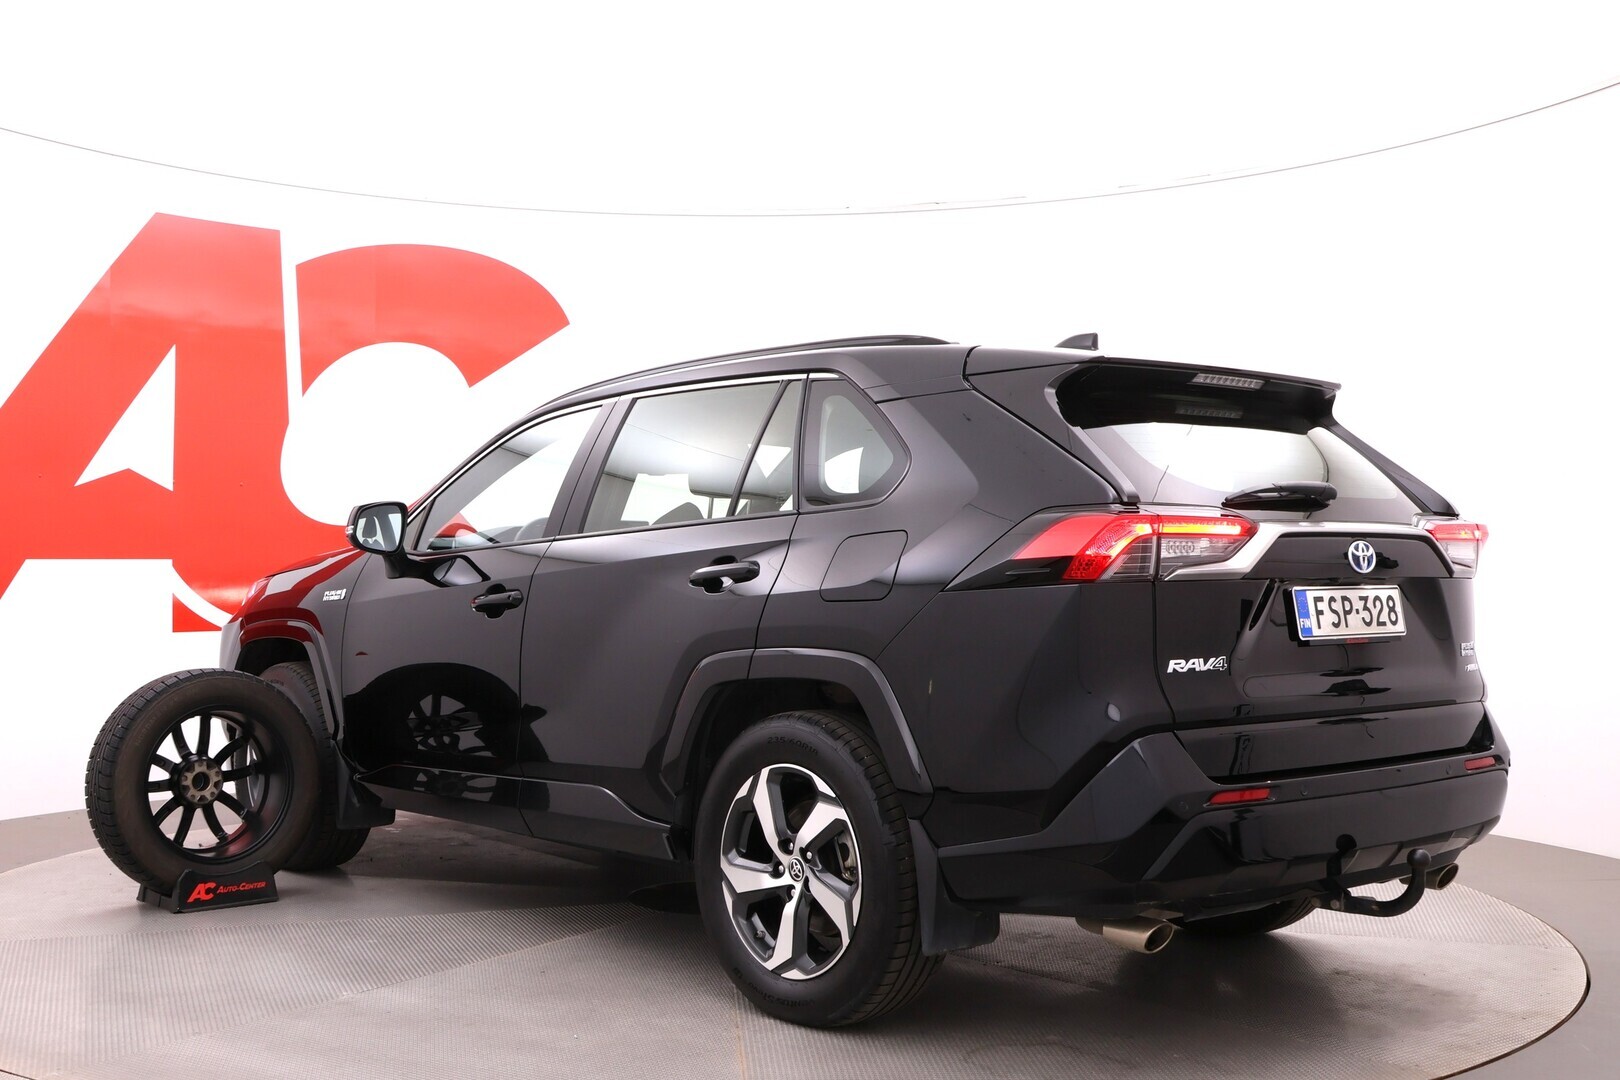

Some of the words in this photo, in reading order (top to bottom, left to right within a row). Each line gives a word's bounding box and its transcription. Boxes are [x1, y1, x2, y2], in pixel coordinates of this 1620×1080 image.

[1313, 594, 1399, 629] FSP-328
[1300, 618, 1311, 628] FIN
[1167, 656, 1227, 673] RAV4
[187, 882, 217, 903] AC
